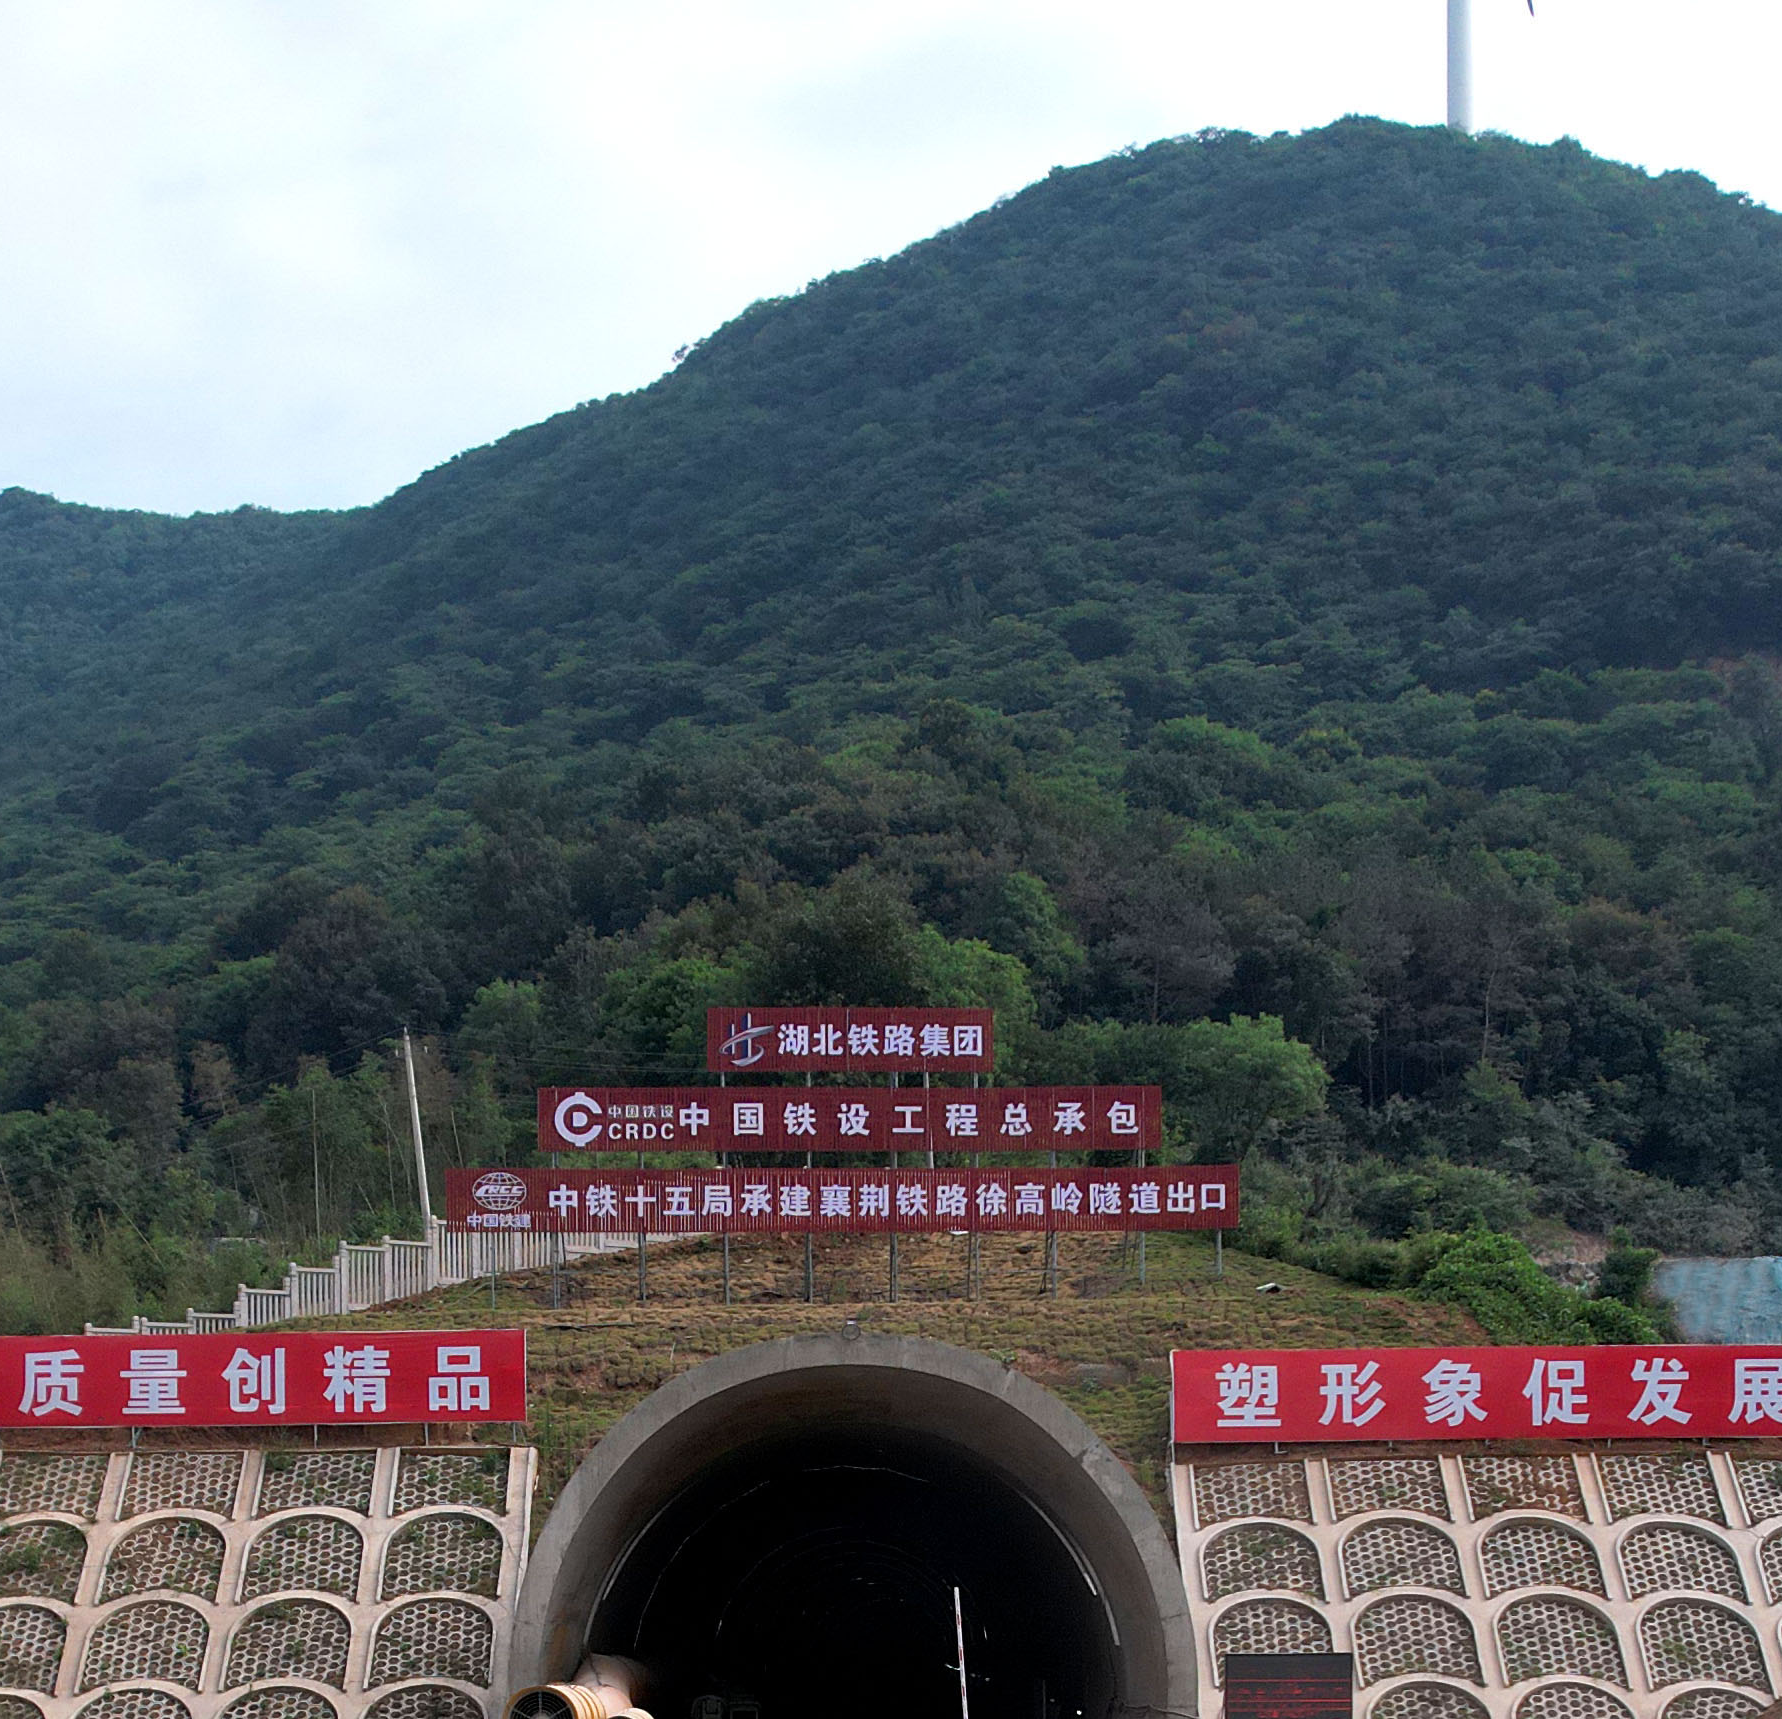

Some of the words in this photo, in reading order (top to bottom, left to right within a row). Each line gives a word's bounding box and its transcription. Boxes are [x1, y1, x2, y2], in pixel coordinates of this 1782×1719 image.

[778, 1023, 983, 1057] 湖北铁路集团
[608, 1104, 673, 1118] 中国铁设
[679, 1101, 1140, 1136] 中国铁设工程总承包
[608, 1122, 674, 1140] CRDC
[548, 1181, 1227, 1219] 中铁十五局承建襄荆铁路徐高岭隧道出口
